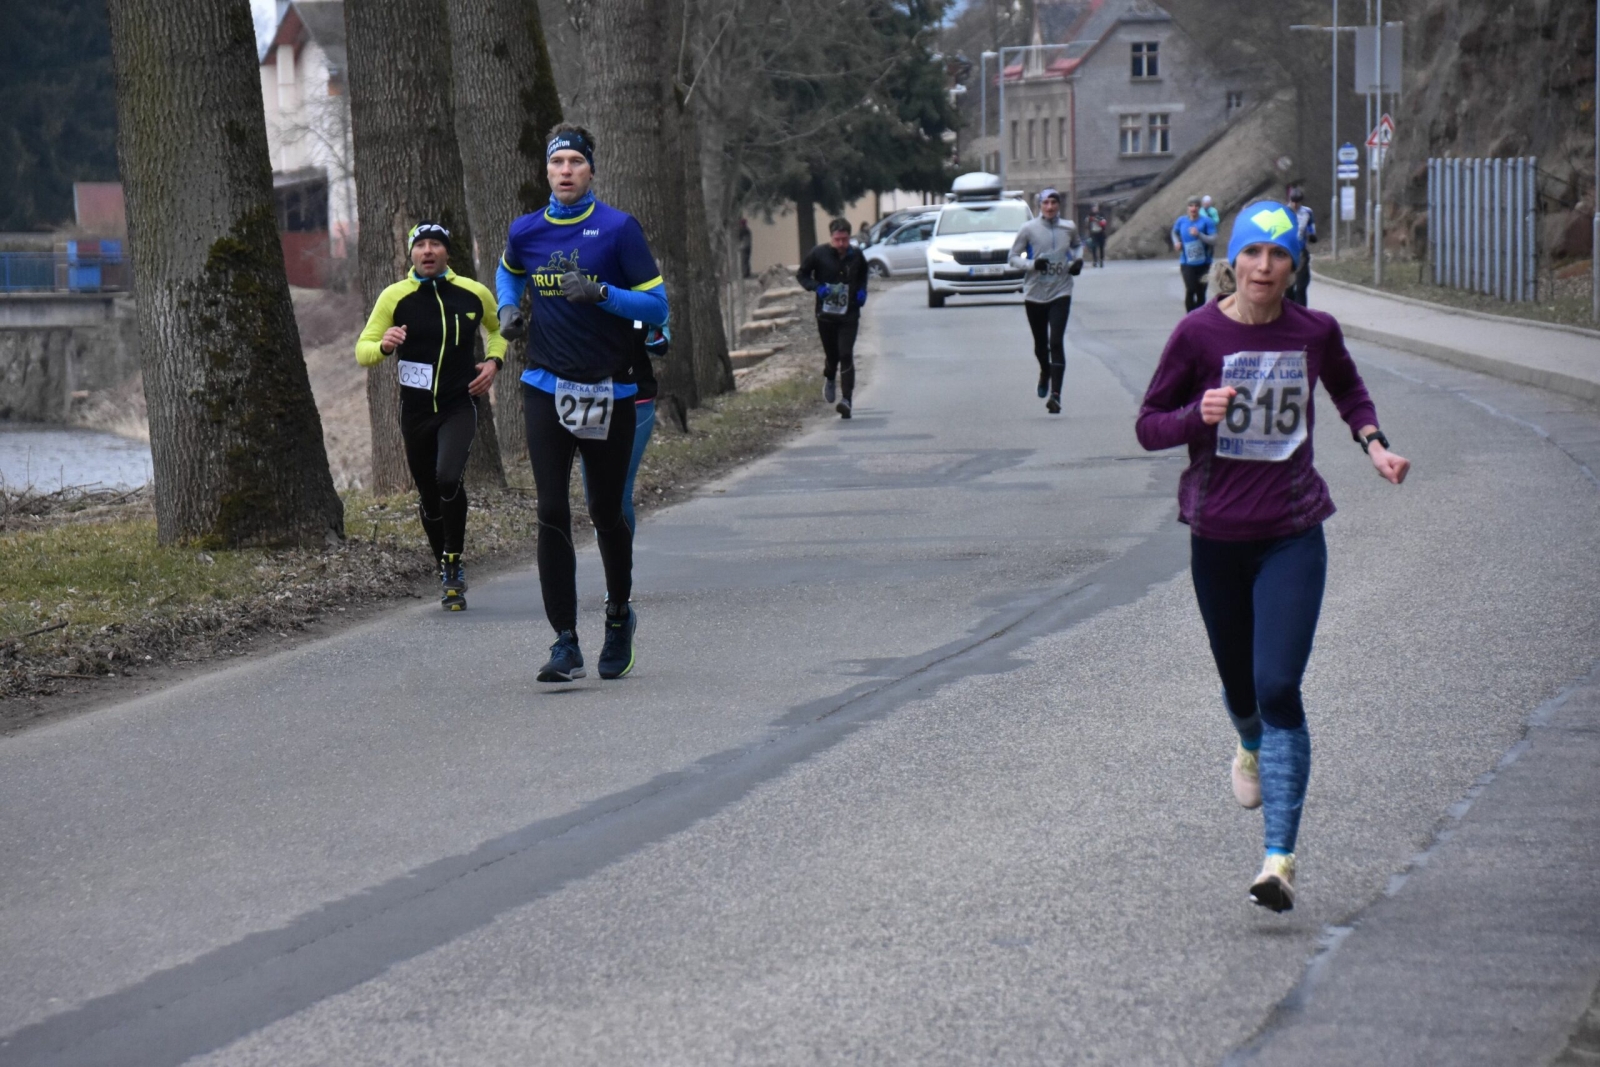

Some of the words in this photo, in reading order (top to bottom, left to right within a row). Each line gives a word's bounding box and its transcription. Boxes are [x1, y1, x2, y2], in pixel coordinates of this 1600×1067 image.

[531, 273, 598, 287] TRUTV
[400, 364, 431, 387] 635
[1280, 369, 1303, 379] LIGA
[561, 394, 609, 425] 271
[1225, 386, 1302, 435] 615
